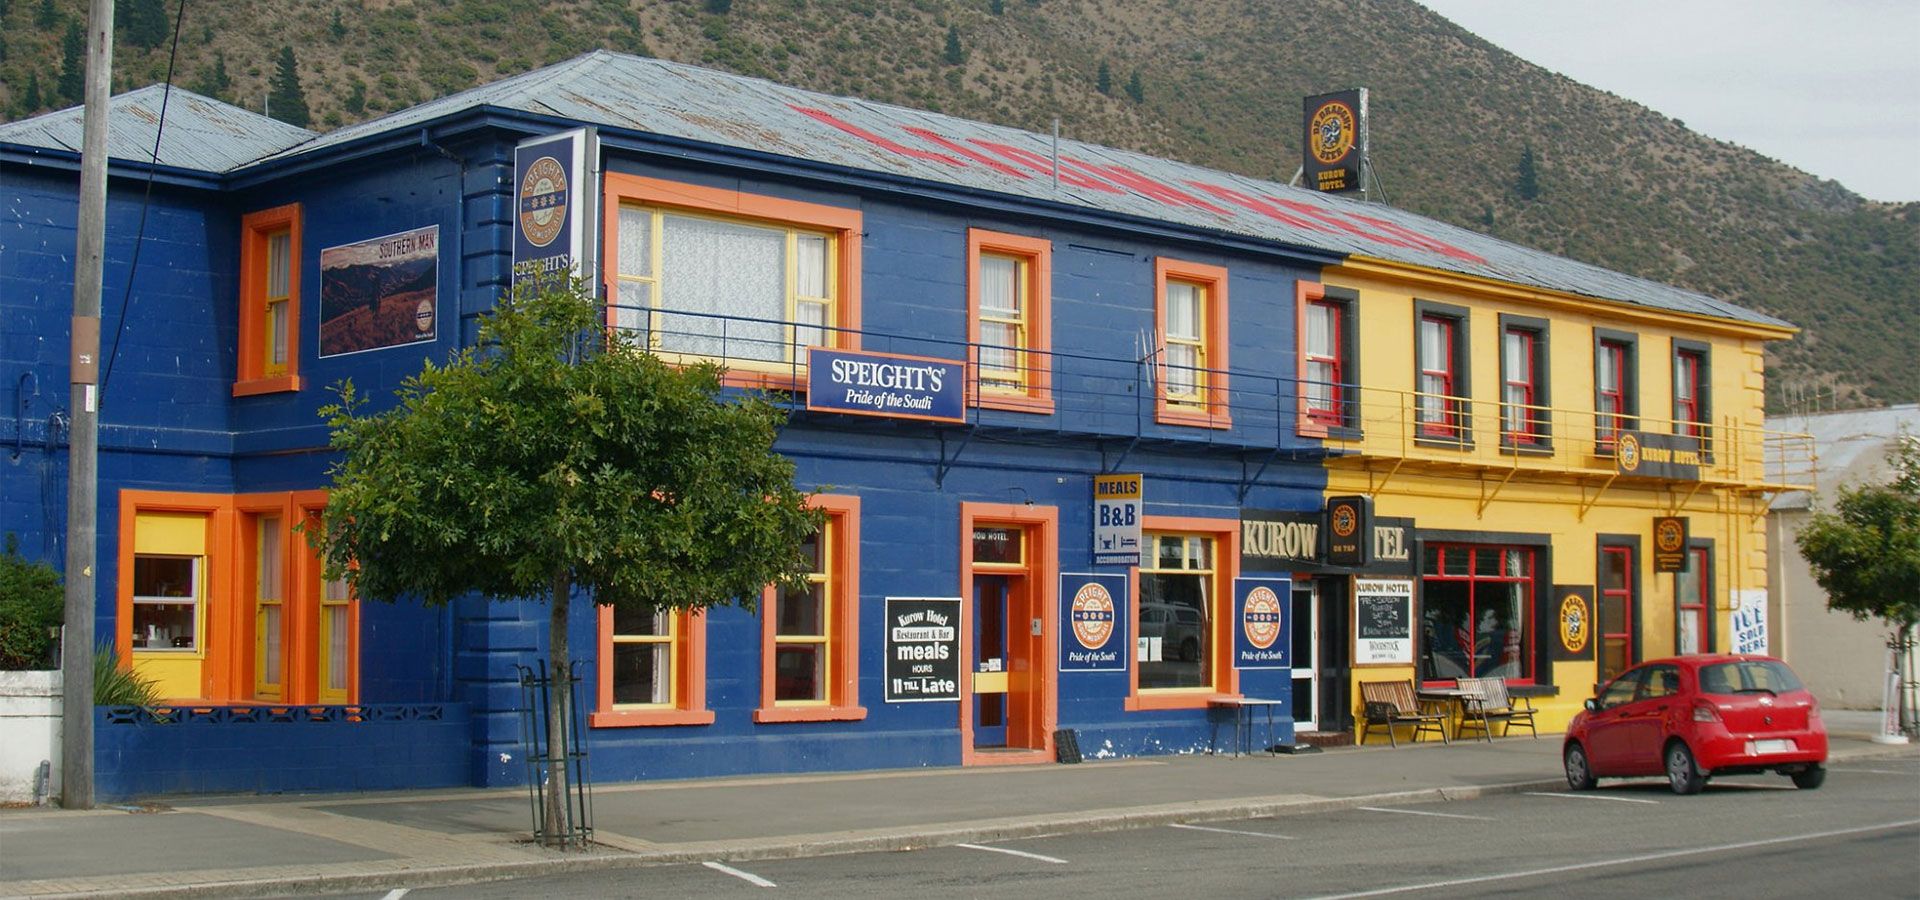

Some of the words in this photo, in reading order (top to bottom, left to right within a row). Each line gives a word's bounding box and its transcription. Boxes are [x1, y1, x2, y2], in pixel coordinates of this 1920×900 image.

[1319, 105, 1352, 131] DRAUGHT
[1320, 148, 1343, 160] BEER
[1318, 168, 1345, 180] KUROW
[1319, 180, 1345, 191] HOTEL
[379, 238, 416, 259] SOUTHERN
[418, 233, 435, 250] MAN
[832, 358, 943, 392] SPEIGHT'S
[845, 388, 873, 404] Pride
[874, 393, 887, 408] of
[887, 393, 904, 407] the
[903, 395, 931, 410] South
[1641, 447, 1671, 464] KUROW
[1098, 481, 1137, 495] MEALS
[1100, 504, 1135, 526] B&B
[1242, 520, 1318, 560] KUROW
[1374, 527, 1409, 561] TEL
[1096, 555, 1138, 564] ACCOMMODATION
[1357, 583, 1384, 592] KUROW
[1386, 584, 1410, 592] HOTEL
[898, 612, 924, 627] Kurow
[926, 610, 948, 627] Hotel
[1734, 605, 1764, 631] ICE
[897, 629, 929, 639] Restaurant
[931, 630, 936, 639] &
[938, 630, 950, 639] Bar
[1739, 625, 1764, 642] SOLD
[897, 641, 949, 660] meals
[1739, 637, 1766, 654] HERE
[1069, 651, 1084, 661] Pride
[1084, 651, 1091, 663] of
[1091, 651, 1100, 661] the
[1100, 651, 1116, 661] South
[1241, 650, 1254, 660] Pride
[912, 664, 933, 673] HOURS
[903, 681, 919, 690] TILL
[922, 678, 955, 693] Late
